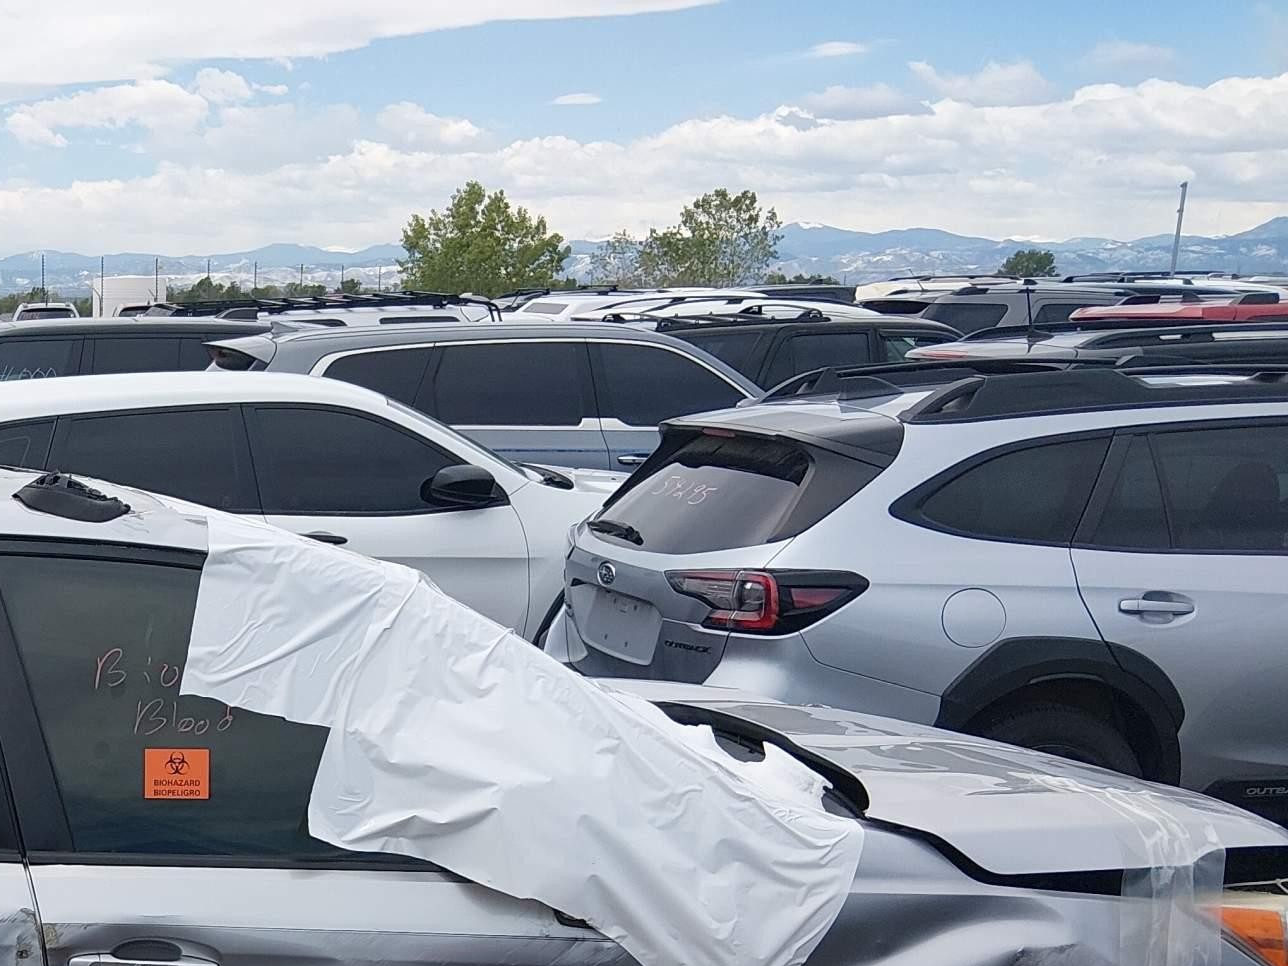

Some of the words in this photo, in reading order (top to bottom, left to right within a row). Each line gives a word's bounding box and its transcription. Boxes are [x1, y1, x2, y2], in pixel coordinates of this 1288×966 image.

[134, 698, 233, 736] Blood
[153, 779, 201, 787] BIOHAZARD
[153, 789, 201, 797] BIOPELIGRO
